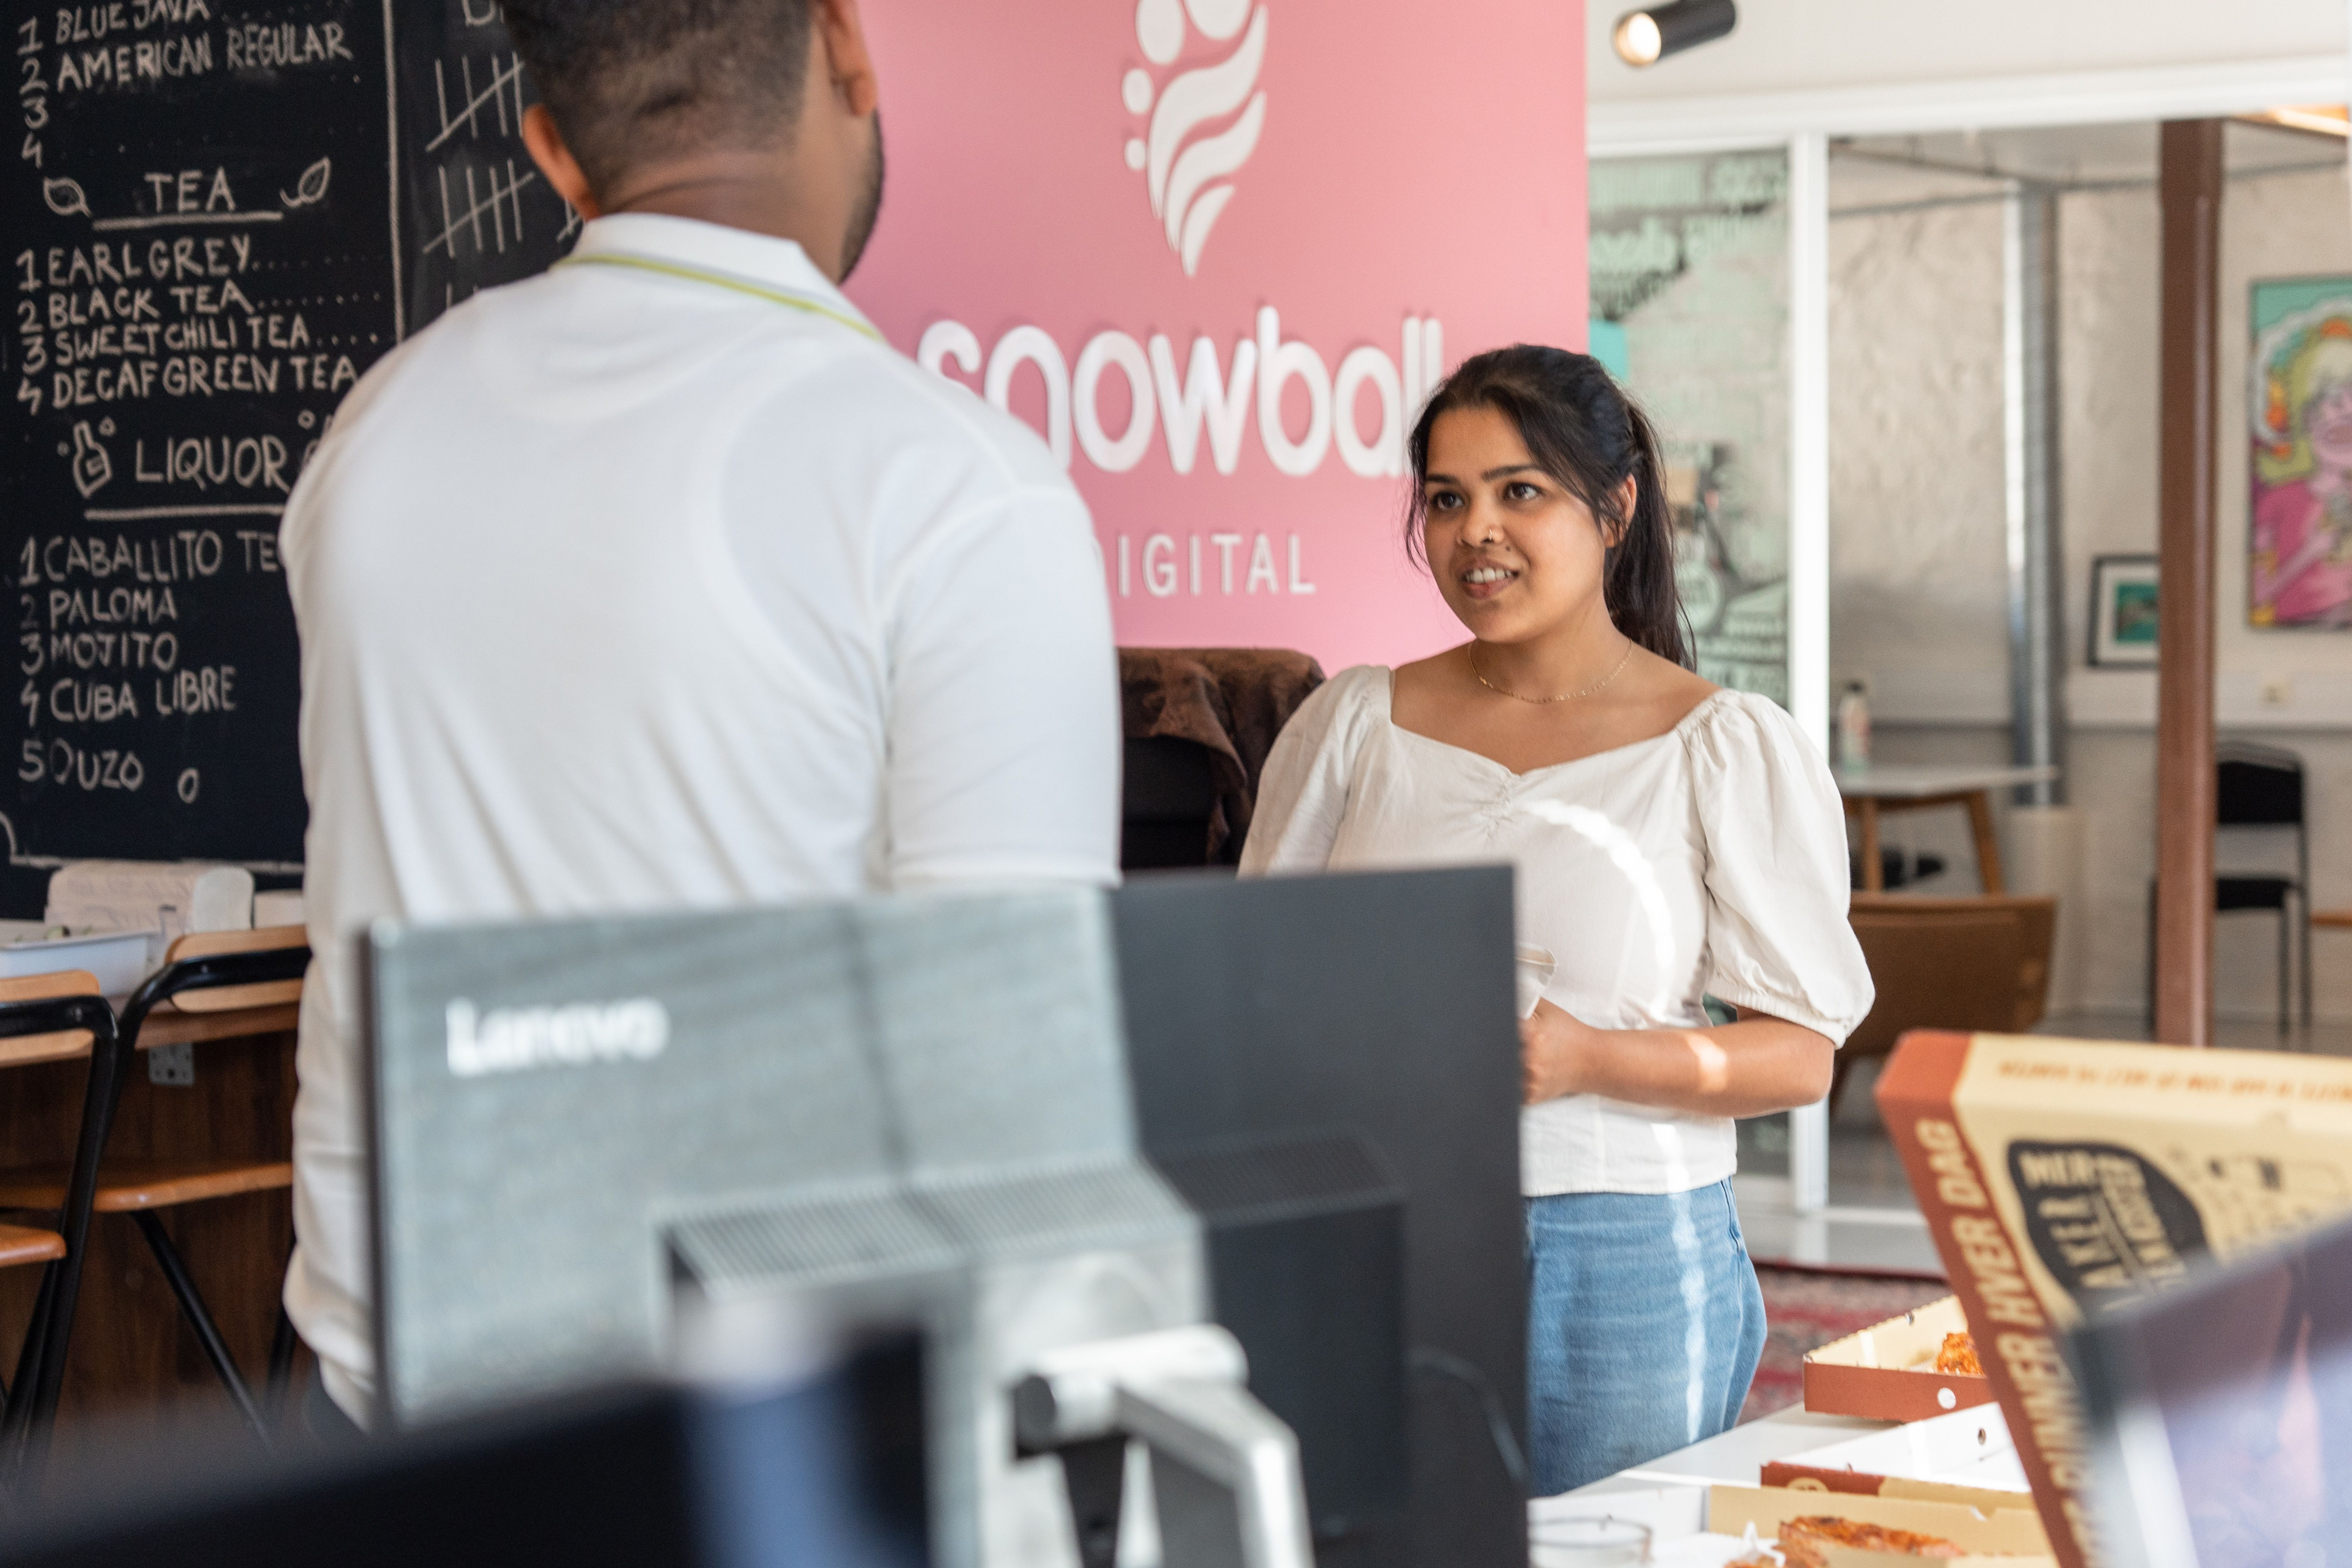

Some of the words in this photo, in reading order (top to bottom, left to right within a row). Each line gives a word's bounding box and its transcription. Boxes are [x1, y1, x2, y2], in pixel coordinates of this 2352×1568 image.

[17, 16, 44, 56] 1
[56, 3, 129, 44] BLUE
[19, 57, 49, 95] 2
[57, 32, 213, 93] AMERICAN
[227, 20, 354, 70] REGULAR
[24, 96, 49, 129] 3
[21, 133, 42, 169] 4
[144, 165, 236, 212] TEA
[16, 249, 42, 292] 1
[48, 241, 142, 286] EARL
[149, 232, 252, 281] GREY
[17, 300, 43, 334] 2
[48, 288, 160, 330] BLACK
[169, 278, 254, 314] TEA
[22, 334, 47, 374] 3
[56, 323, 160, 367] SWEET
[164, 317, 237, 350] CHILI
[246, 314, 310, 349] TEA
[17, 377, 42, 416] 4
[52, 358, 159, 409] DECAF
[163, 355, 280, 397] GREEN
[290, 353, 358, 392] TEA
[136, 435, 291, 493] LIQUOR
[19, 535, 40, 587] 1
[44, 530, 223, 583] CABALLITO
[237, 530, 280, 574] TE
[1094, 533, 1316, 598] IGITAL
[49, 587, 178, 631] PALOMA
[20, 632, 45, 676] 3
[50, 630, 179, 672] MOJITO
[20, 678, 40, 728] 4
[50, 677, 138, 723] CUBA
[155, 664, 237, 715] LIBRE
[18, 737, 46, 782] 5
[49, 737, 145, 791] OUZO
[1916, 1117, 1987, 1207] DAG
[1953, 1214, 2045, 1329] HVER
